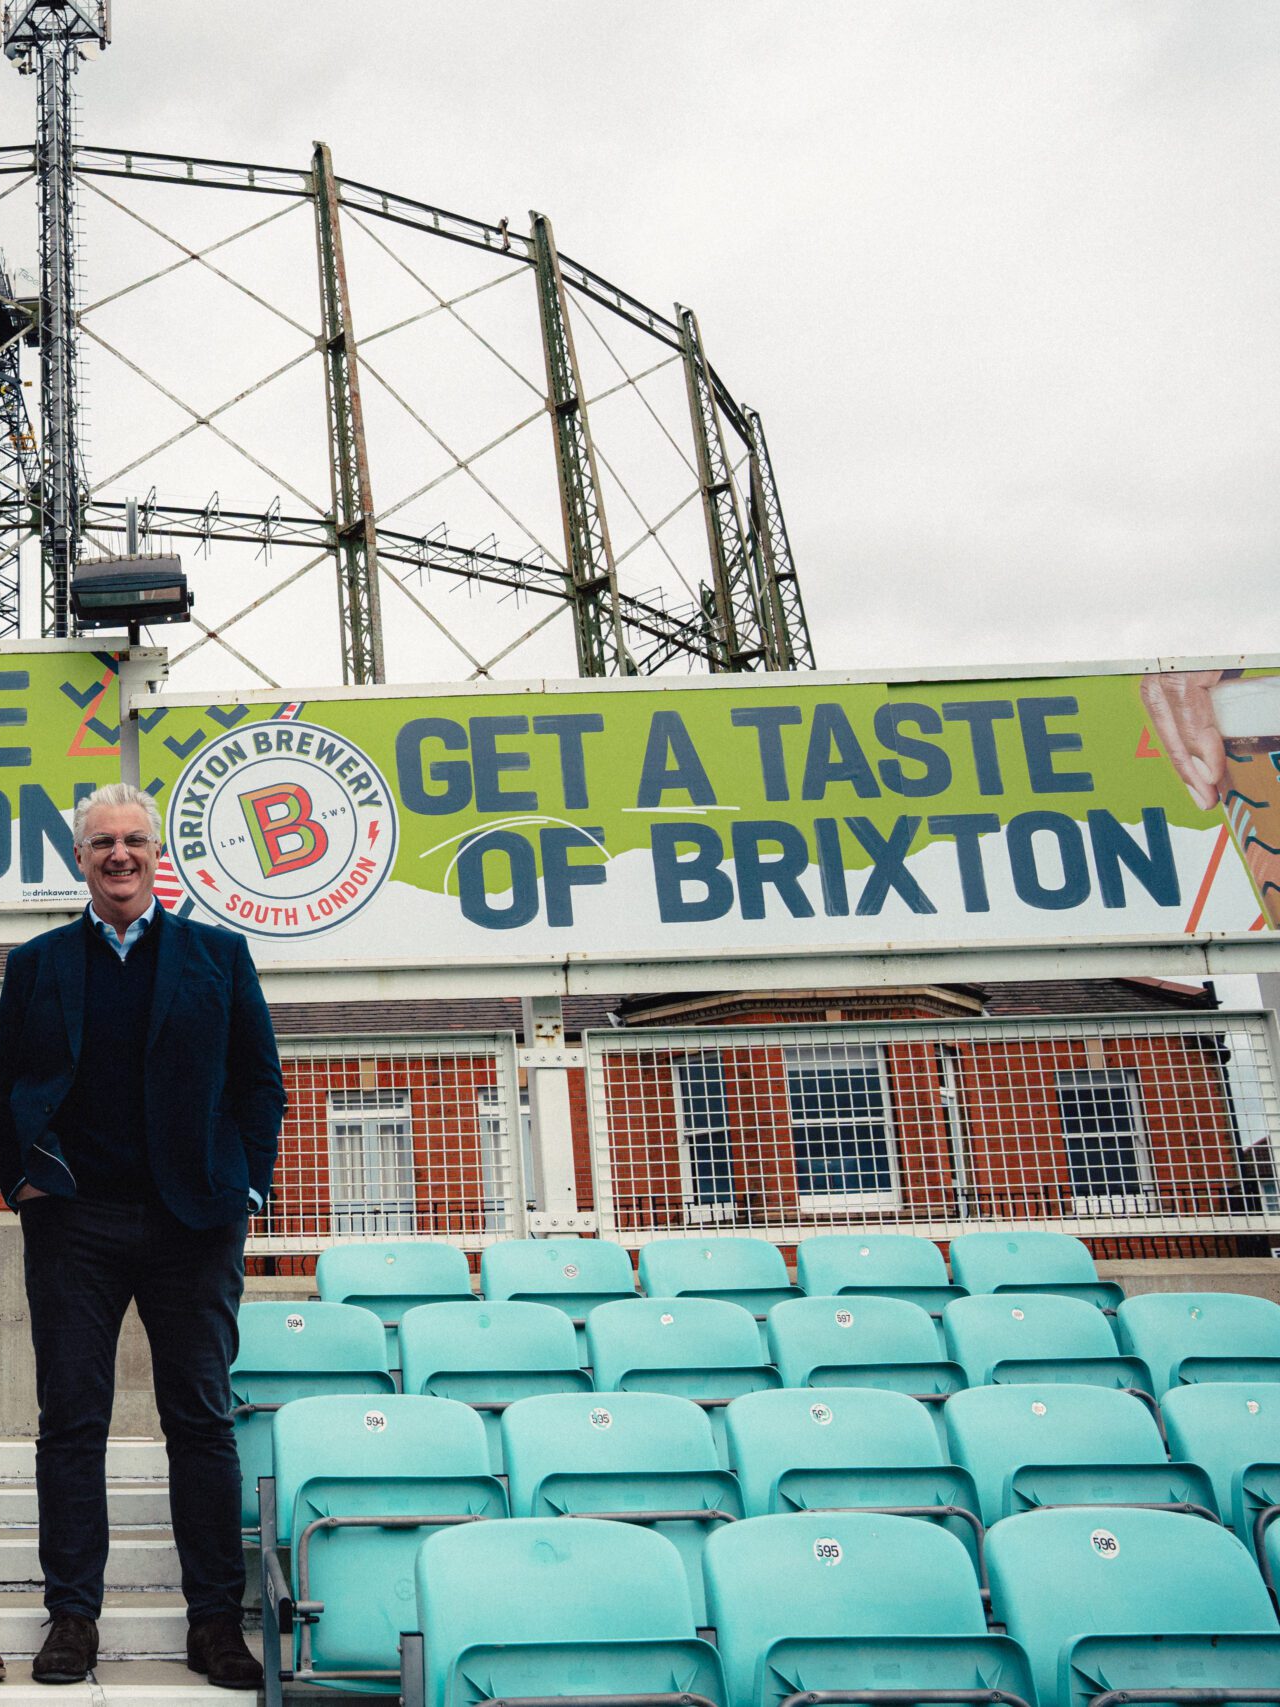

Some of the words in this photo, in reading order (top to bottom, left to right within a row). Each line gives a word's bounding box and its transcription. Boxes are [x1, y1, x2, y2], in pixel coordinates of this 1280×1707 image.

[396, 712, 605, 817] GET
[637, 710, 718, 808] A
[730, 695, 1094, 801] TASTE
[179, 740, 248, 862] BRIXTON
[252, 729, 383, 809] BREWERY
[220, 835, 246, 848] LDN
[321, 807, 346, 820] SW9
[237, 782, 329, 879] B
[457, 825, 607, 930] OF
[650, 806, 1181, 924] BRIXTON
[225, 893, 299, 926] SOUTH
[306, 856, 377, 922] LONDON
[287, 1319, 303, 1328] 594
[836, 1314, 851, 1323] 597
[366, 1416, 384, 1427] 594
[817, 1545, 839, 1558] 595
[1093, 1537, 1117, 1551] 596
